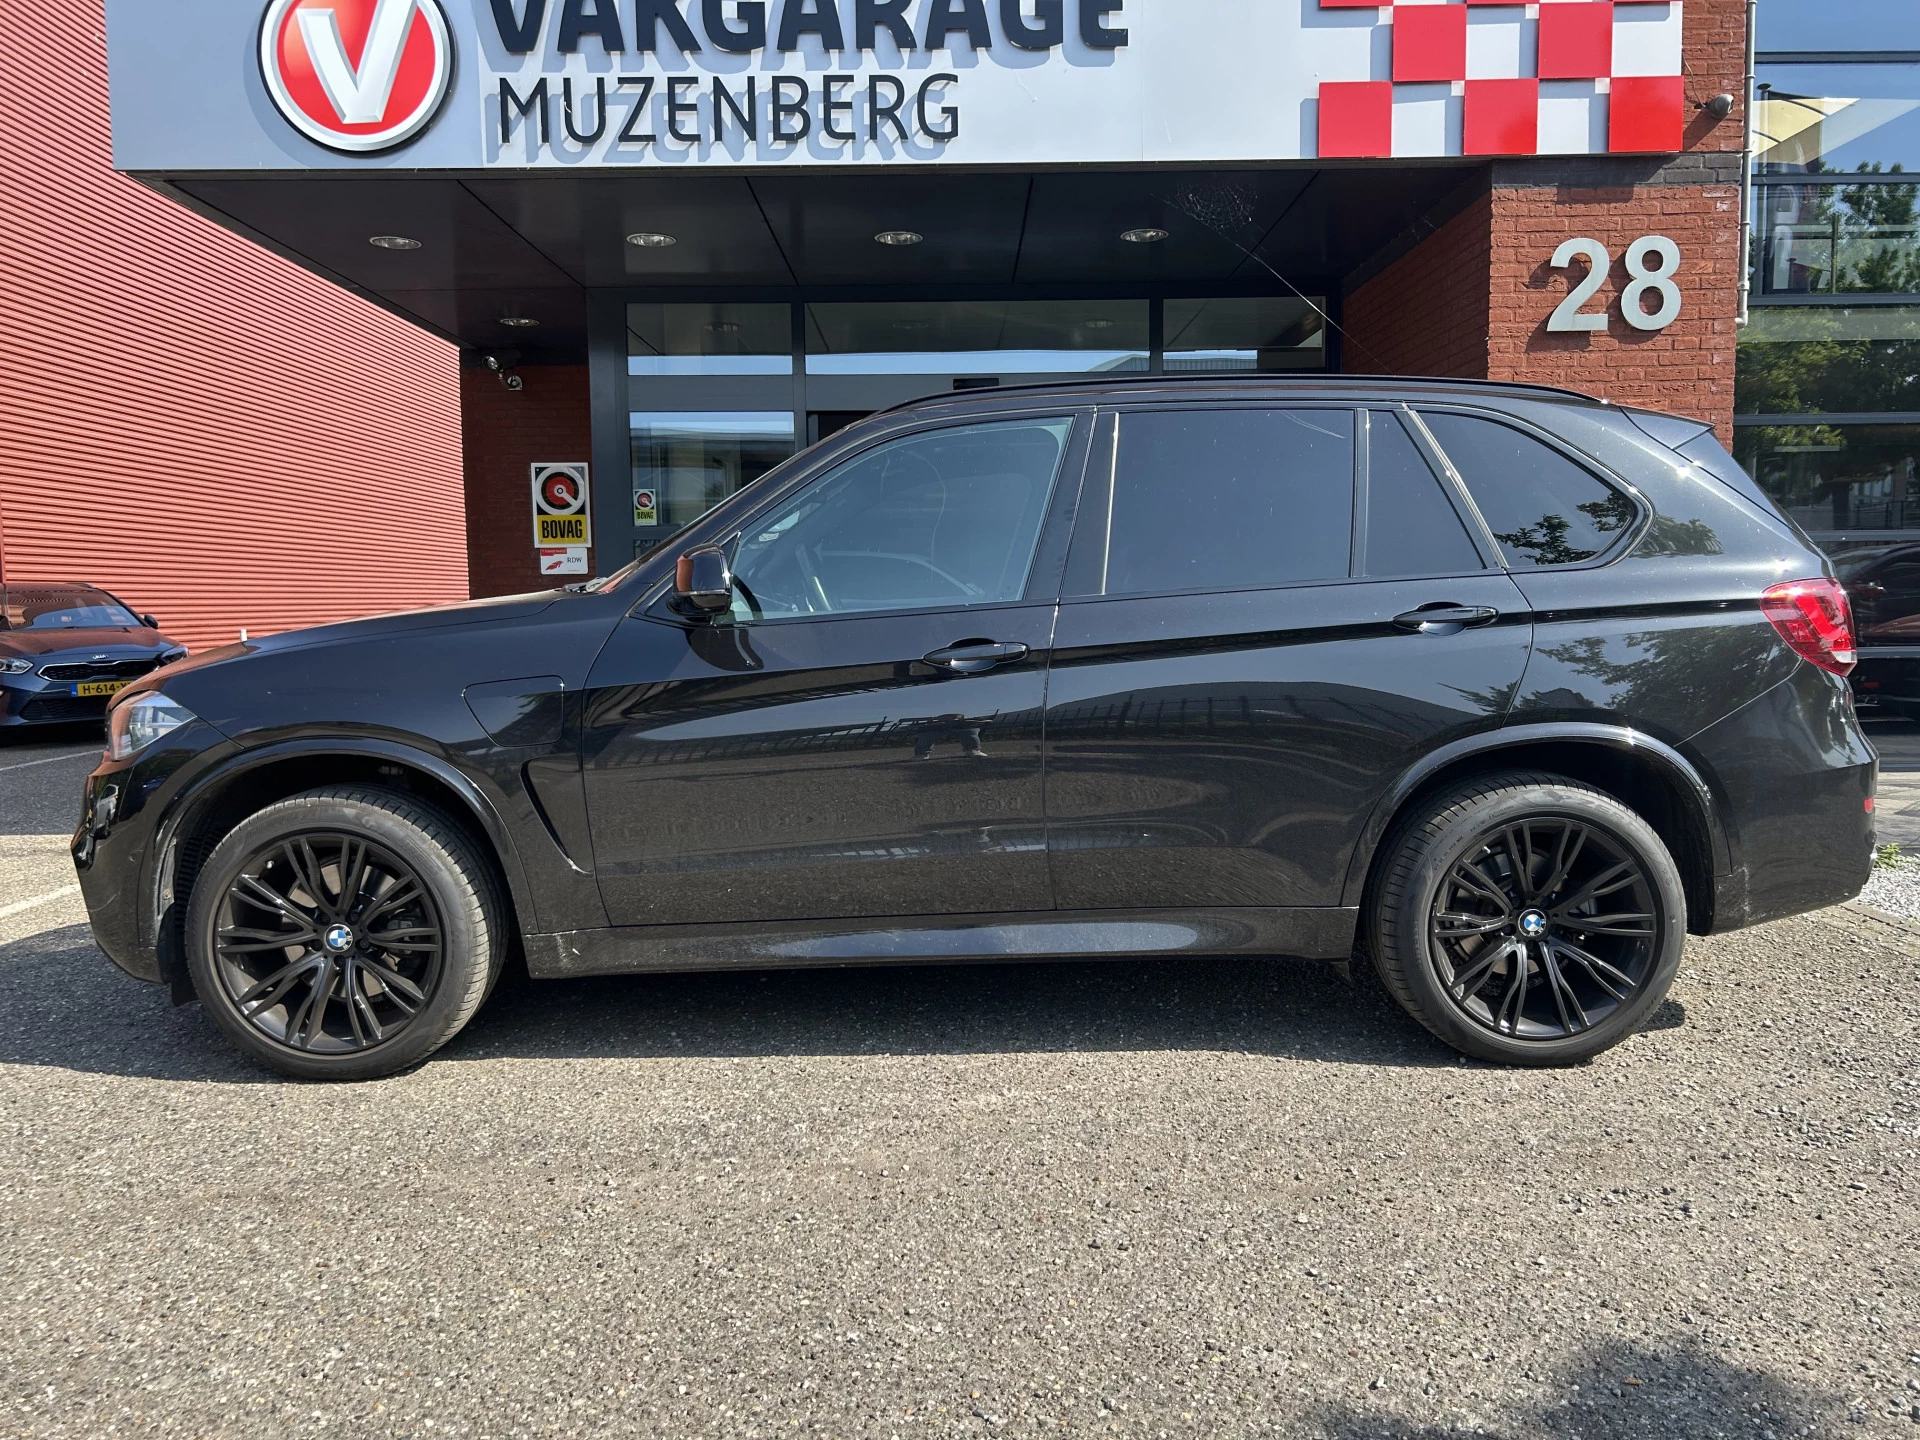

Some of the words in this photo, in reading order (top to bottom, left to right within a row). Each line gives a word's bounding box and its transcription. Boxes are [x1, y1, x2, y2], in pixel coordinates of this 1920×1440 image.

[499, 72, 959, 143] MUZENBERG
[1546, 235, 1681, 332] 28
[637, 511, 654, 520] BOVAG
[541, 519, 583, 539] BOVAG
[82, 682, 131, 695] H-614-
